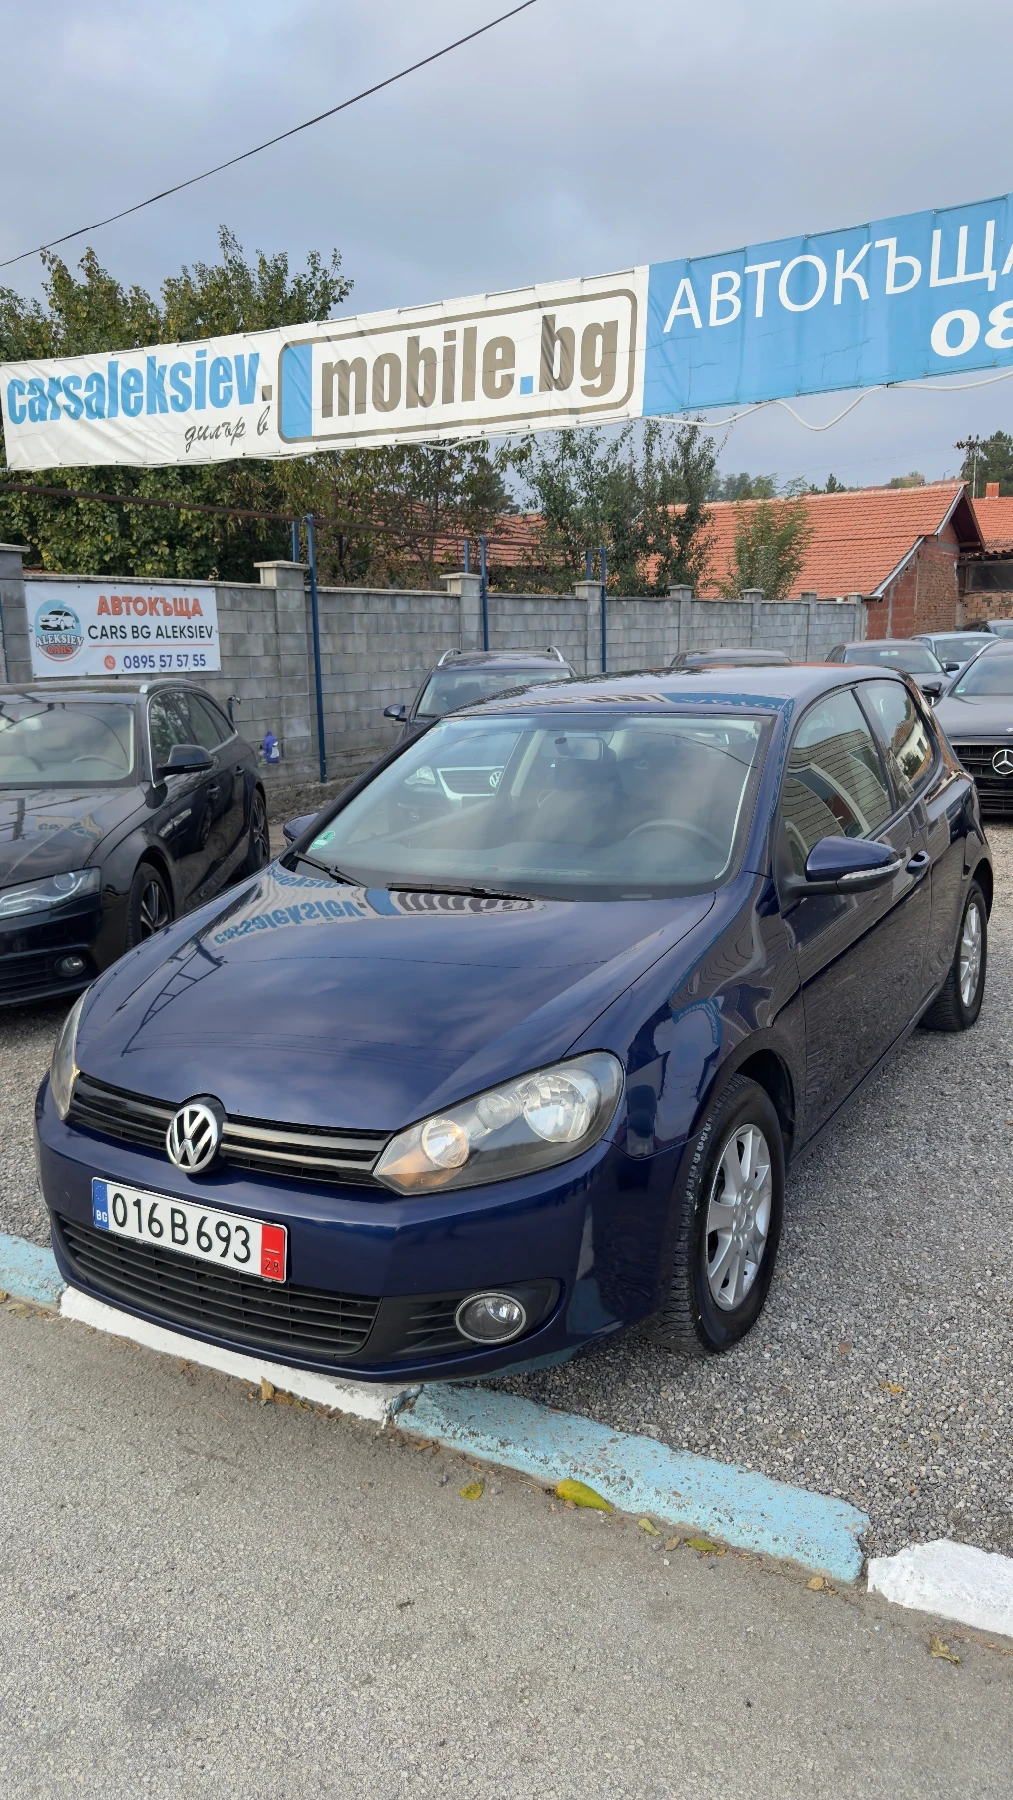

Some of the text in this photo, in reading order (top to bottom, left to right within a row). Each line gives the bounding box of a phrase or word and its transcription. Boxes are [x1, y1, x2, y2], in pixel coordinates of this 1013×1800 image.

[97, 595, 203, 619] АВТОКЪЩА
[36, 633, 84, 647] ALEKSIEV
[87, 625, 213, 640] CARS BG ALEKSIEV
[47, 644, 73, 655] CARS
[123, 654, 206, 669] 0895 57 57 55
[96, 1209, 108, 1223] BG
[264, 1257, 279, 1273] 28
